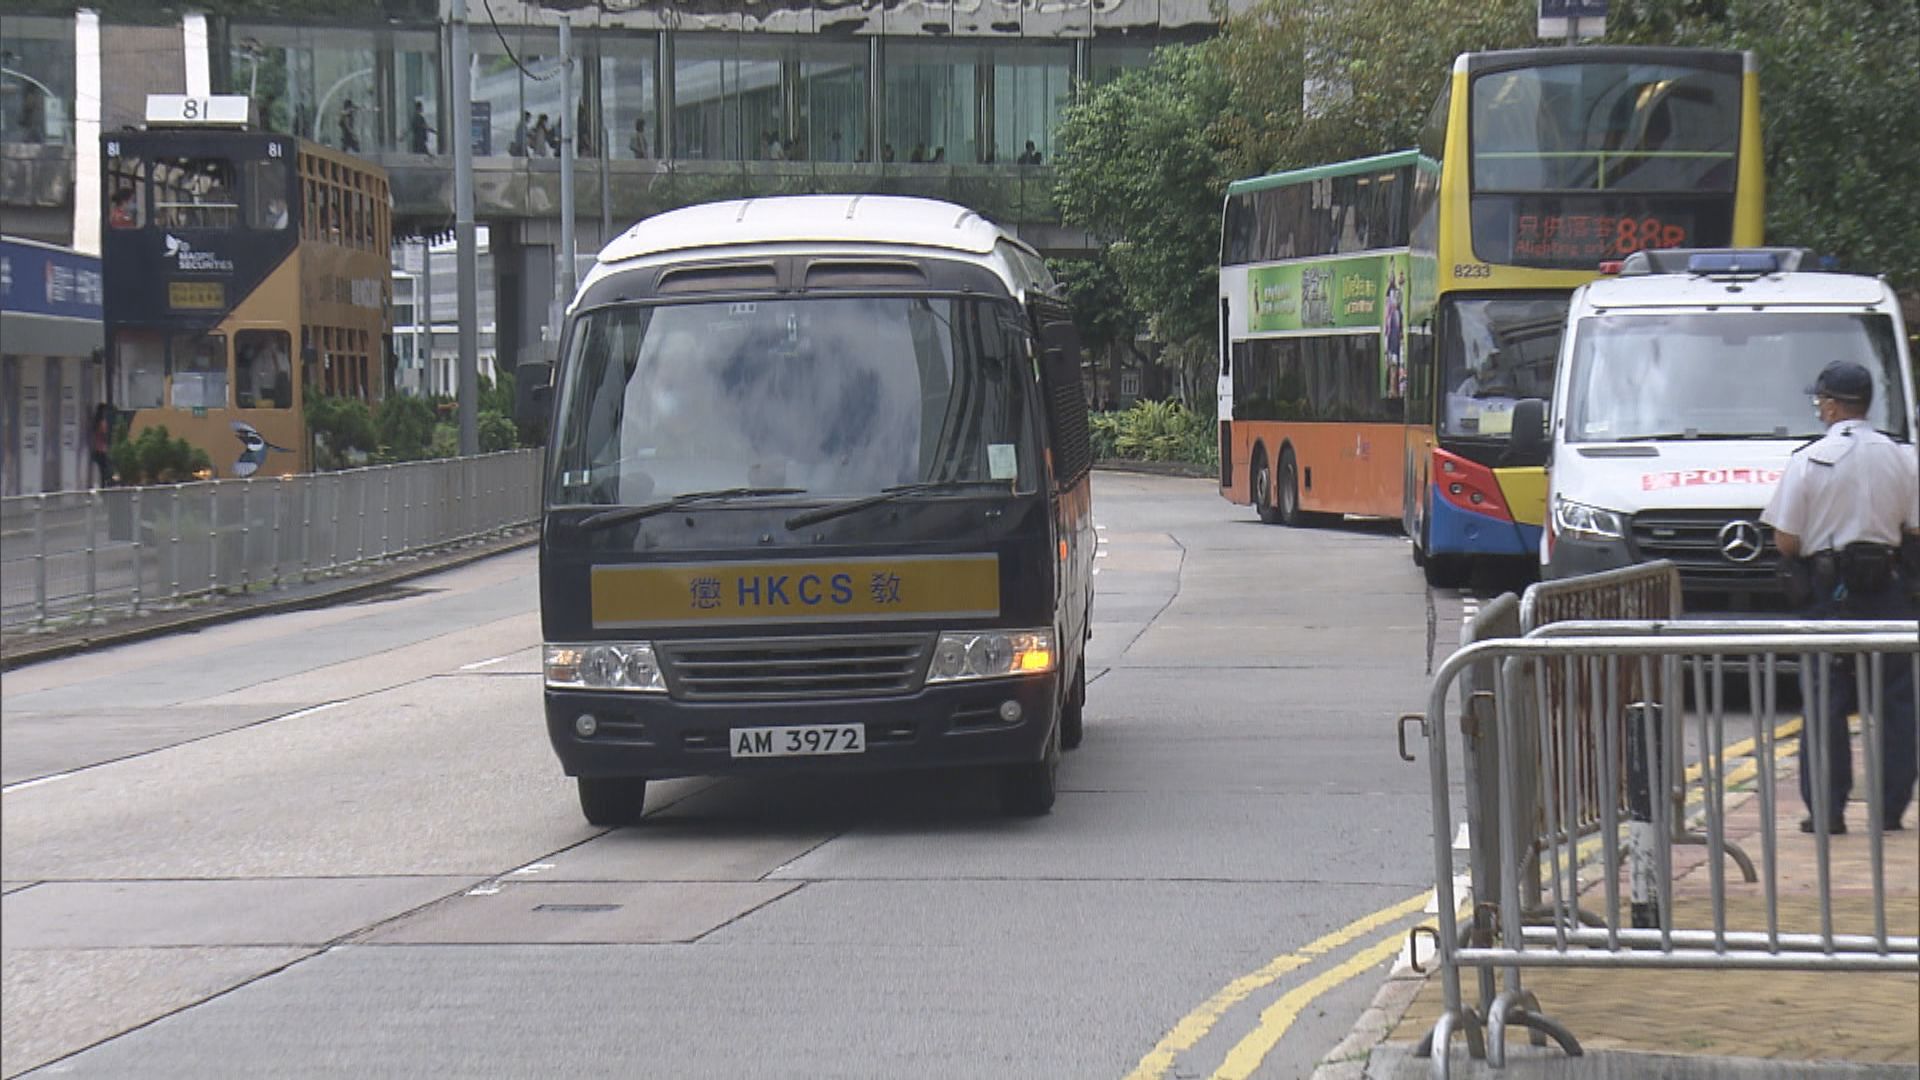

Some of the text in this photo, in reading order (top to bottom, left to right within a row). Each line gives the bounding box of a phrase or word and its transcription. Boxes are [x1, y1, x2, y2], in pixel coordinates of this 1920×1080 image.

[183, 98, 208, 119] 81
[107, 141, 121, 157] 81
[268, 142, 282, 158] 81
[1454, 263, 1491, 279] 8233
[1681, 468, 1784, 487] POLIC
[738, 573, 853, 606] HKCS
[737, 728, 860, 754] AM 3972
